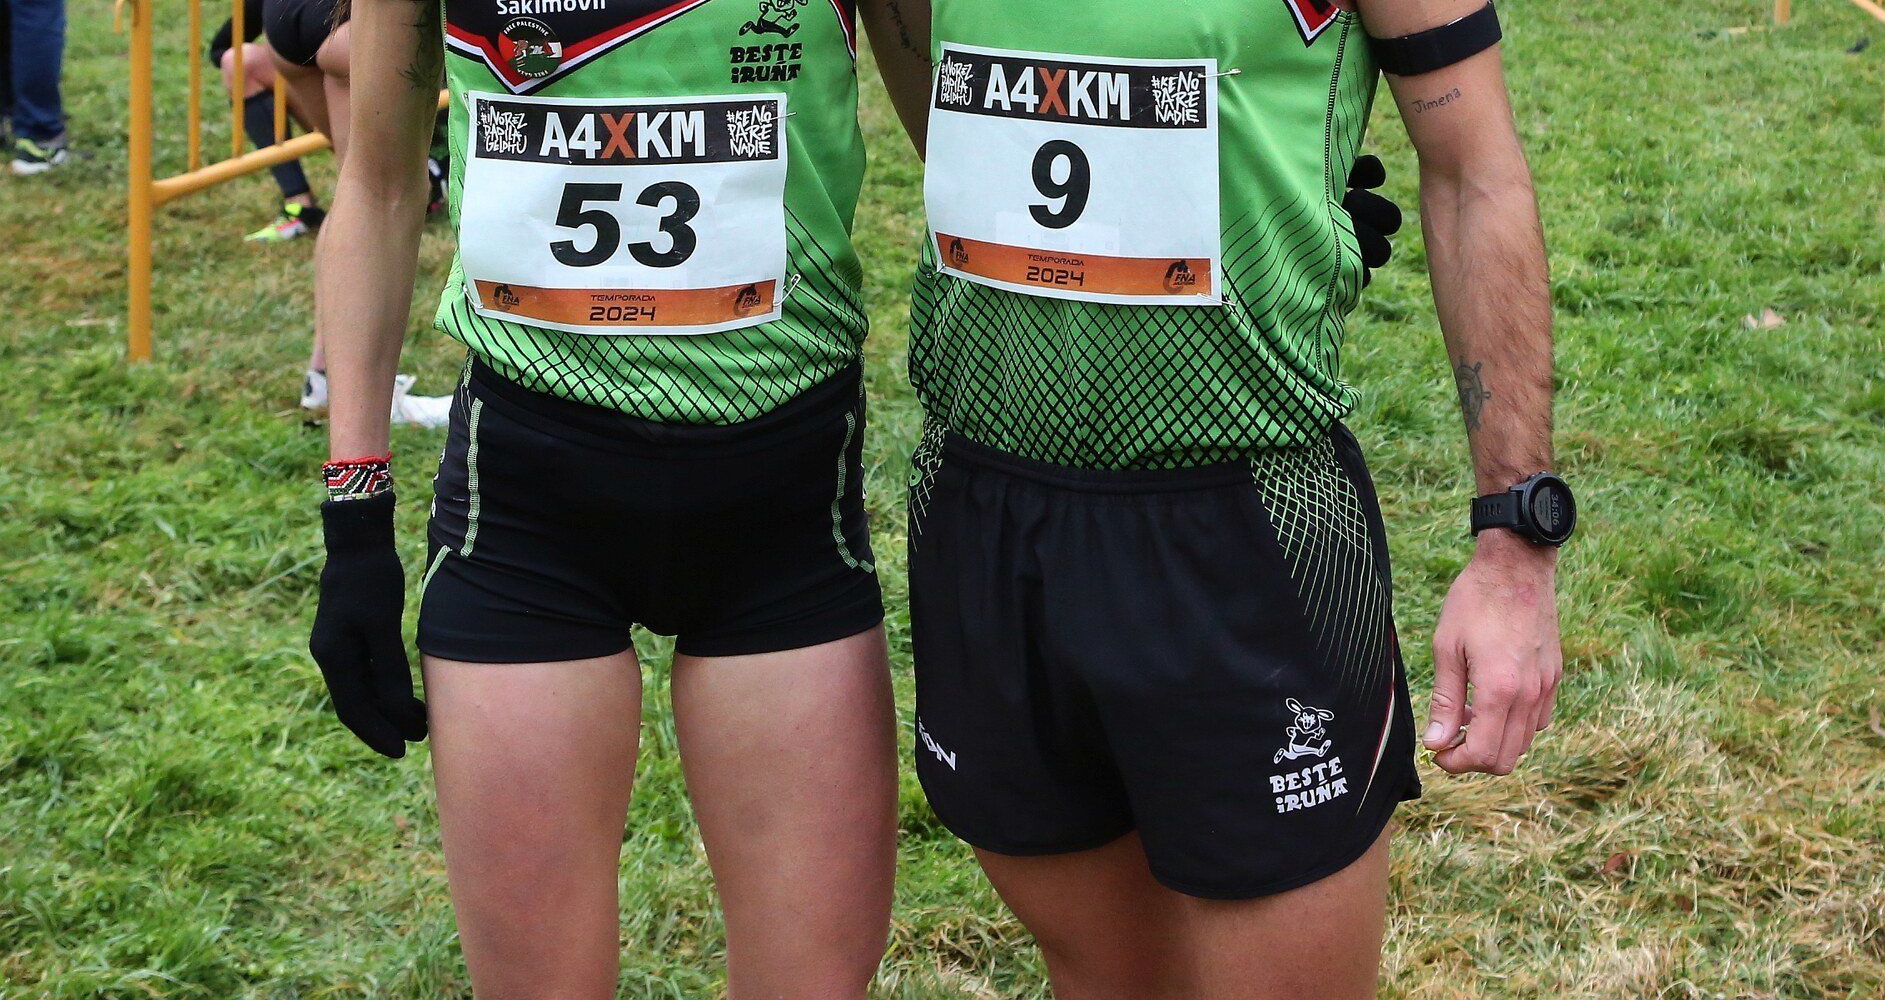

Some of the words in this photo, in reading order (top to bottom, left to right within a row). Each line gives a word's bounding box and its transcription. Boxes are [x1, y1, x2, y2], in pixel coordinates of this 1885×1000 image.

[516, 21, 549, 36] PALESTINE
[729, 42, 803, 65] BESTE
[983, 62, 1131, 122] A4XKM
[1152, 87, 1201, 111] PARE
[1412, 87, 1462, 114] Jimena
[1155, 104, 1200, 126] NADIE
[538, 109, 706, 159] A4XKM
[727, 120, 773, 144] PARE
[730, 136, 772, 158] NADIE
[1028, 139, 1092, 229] 9
[549, 180, 701, 269] 53
[1027, 254, 1085, 267] TEMPORADA
[1026, 266, 1085, 287] 2024
[1174, 273, 1196, 283] FNA
[590, 294, 656, 302] TEMPORADA
[589, 306, 656, 322] 2024
[1269, 756, 1343, 793] BESTE
